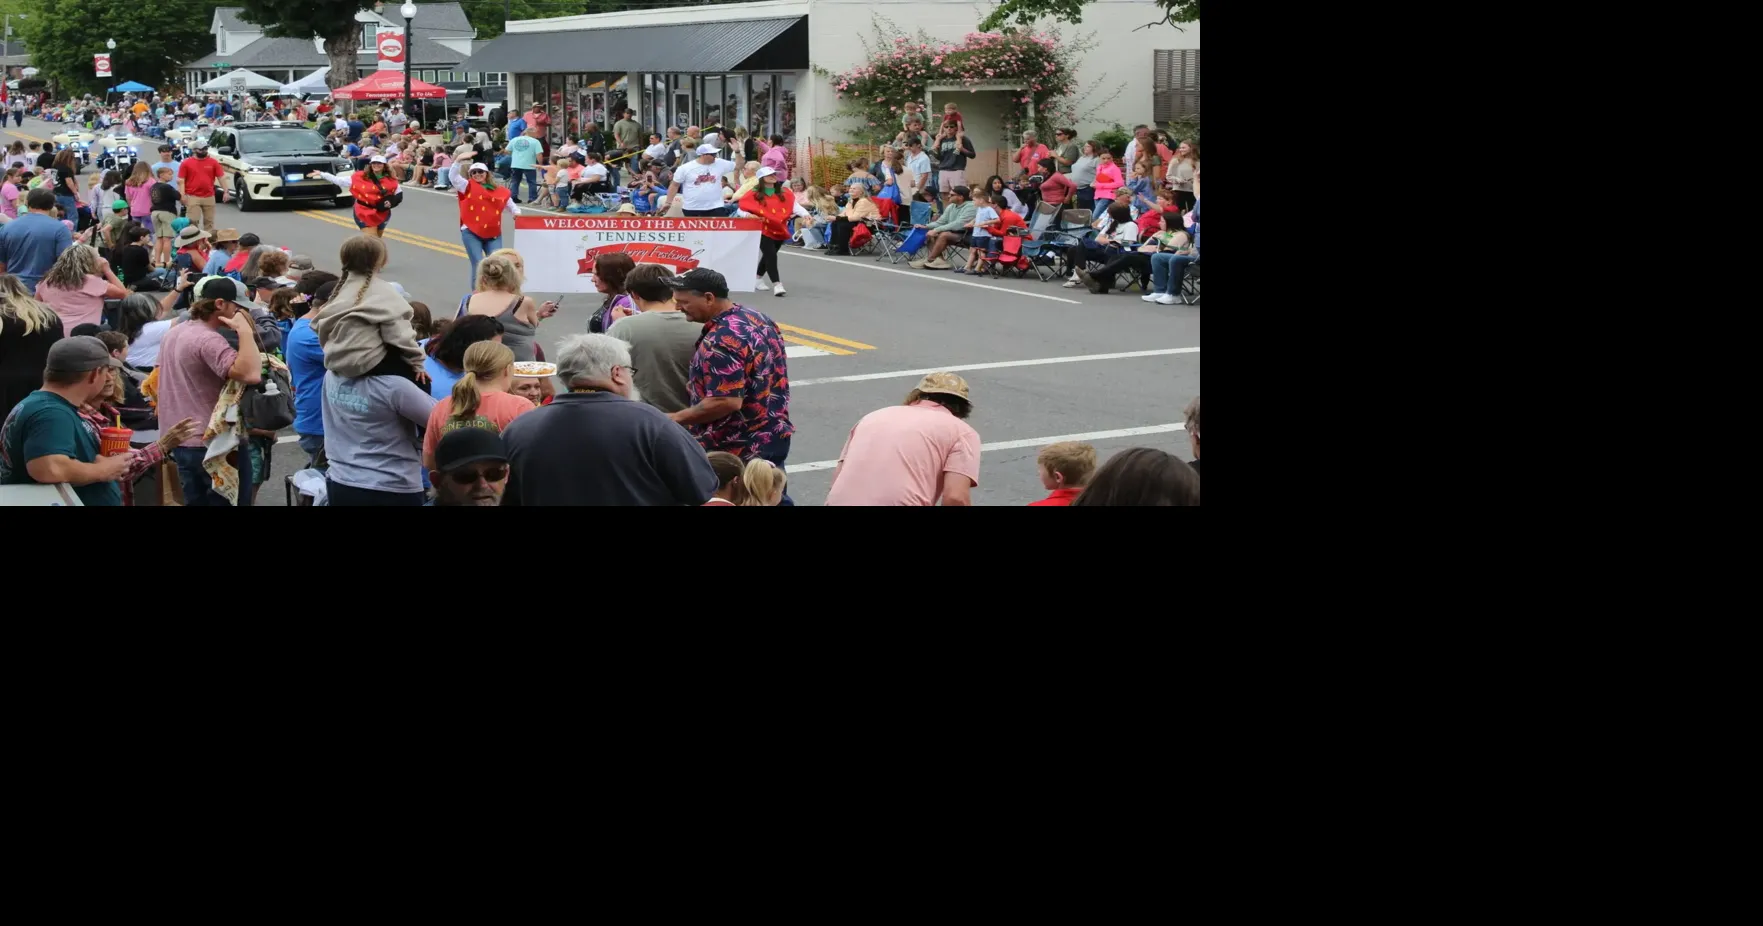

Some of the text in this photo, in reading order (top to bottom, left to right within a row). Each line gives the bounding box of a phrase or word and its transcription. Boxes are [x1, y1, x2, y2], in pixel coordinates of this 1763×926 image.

[543, 218, 737, 229] WELCOME TO THE ANNUAL
[596, 231, 686, 242] TENNESSEE
[648, 245, 705, 263] Festival
